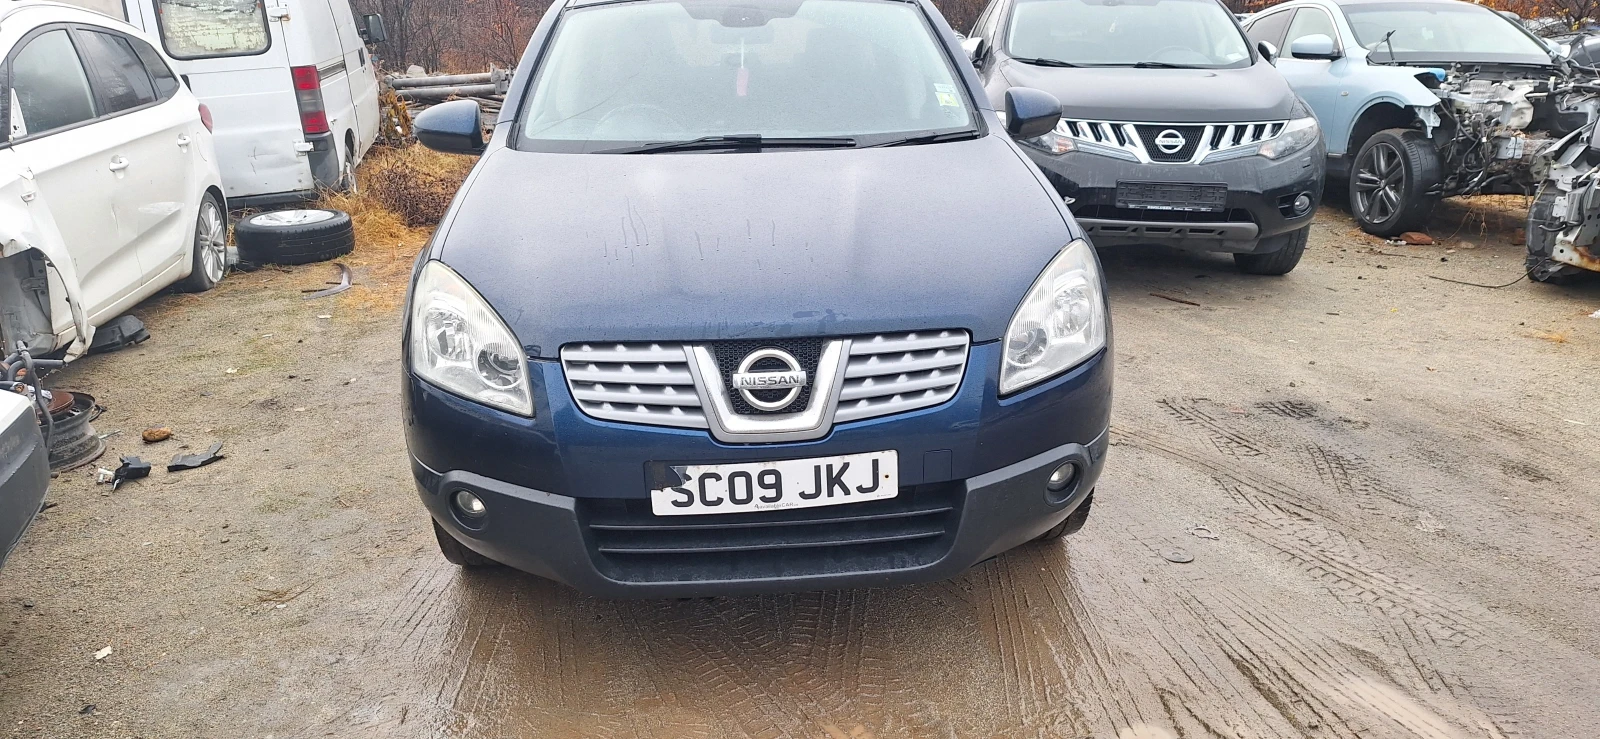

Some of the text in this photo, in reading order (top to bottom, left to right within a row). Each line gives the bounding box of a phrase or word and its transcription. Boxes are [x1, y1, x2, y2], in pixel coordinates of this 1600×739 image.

[741, 374, 799, 386] NISSAN
[671, 458, 880, 508] SC09 JKJ
